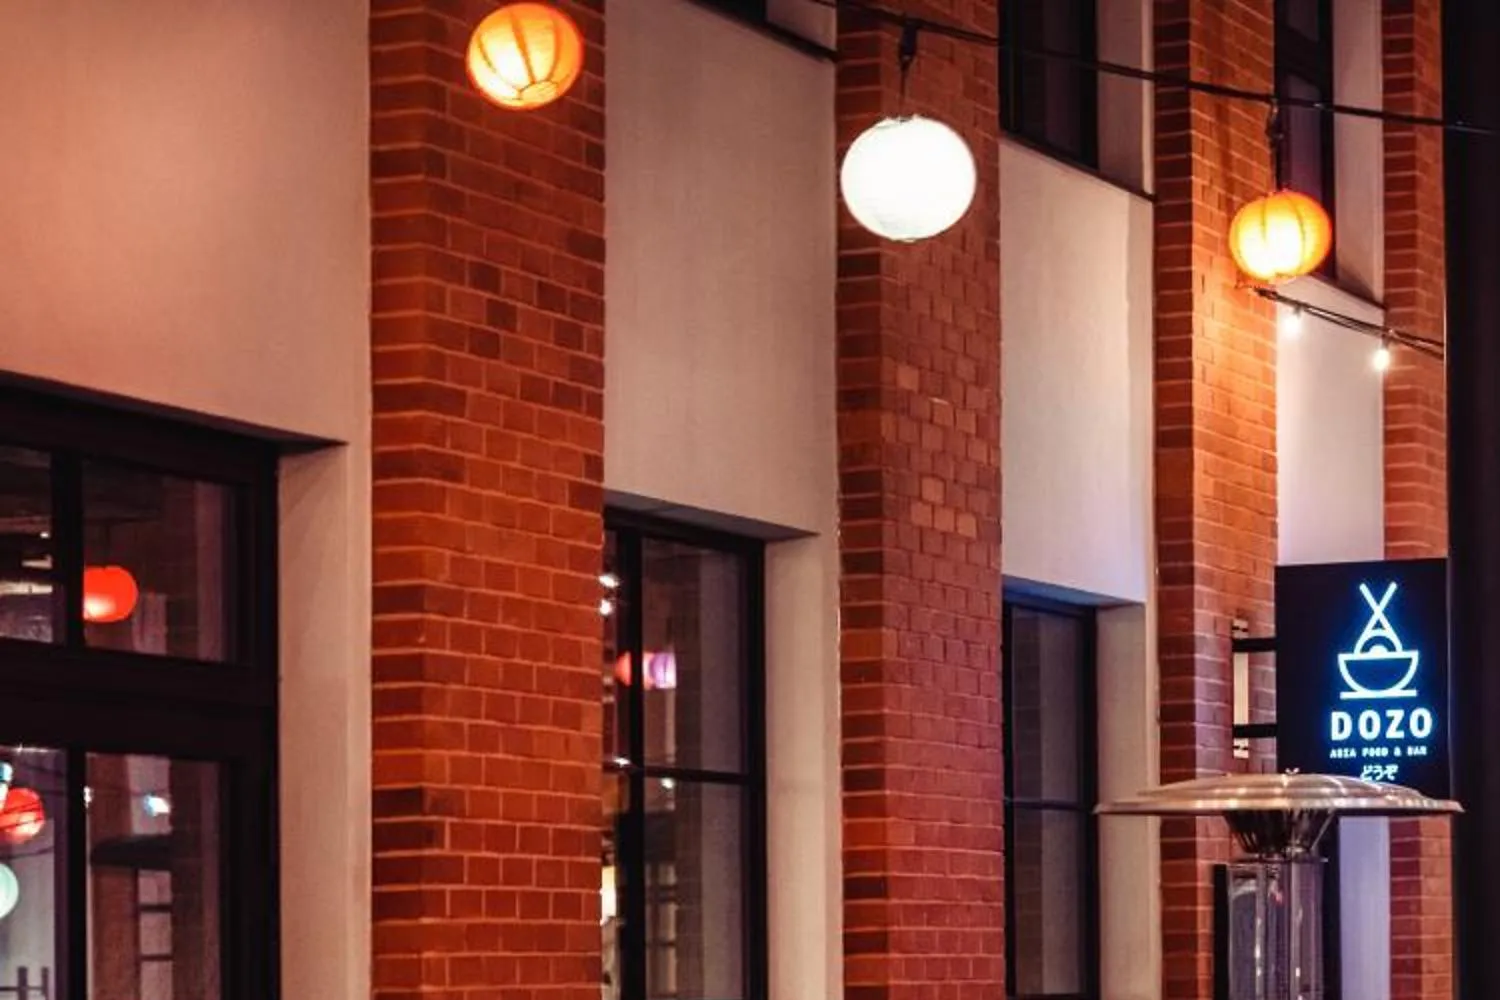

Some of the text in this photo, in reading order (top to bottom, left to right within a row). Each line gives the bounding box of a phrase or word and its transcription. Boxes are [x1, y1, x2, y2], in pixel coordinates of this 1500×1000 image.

[1331, 708, 1433, 741] DOZO
[1330, 745, 1428, 759] ASIA FOOD & BAR
[1359, 764, 1399, 781] どうぞ
